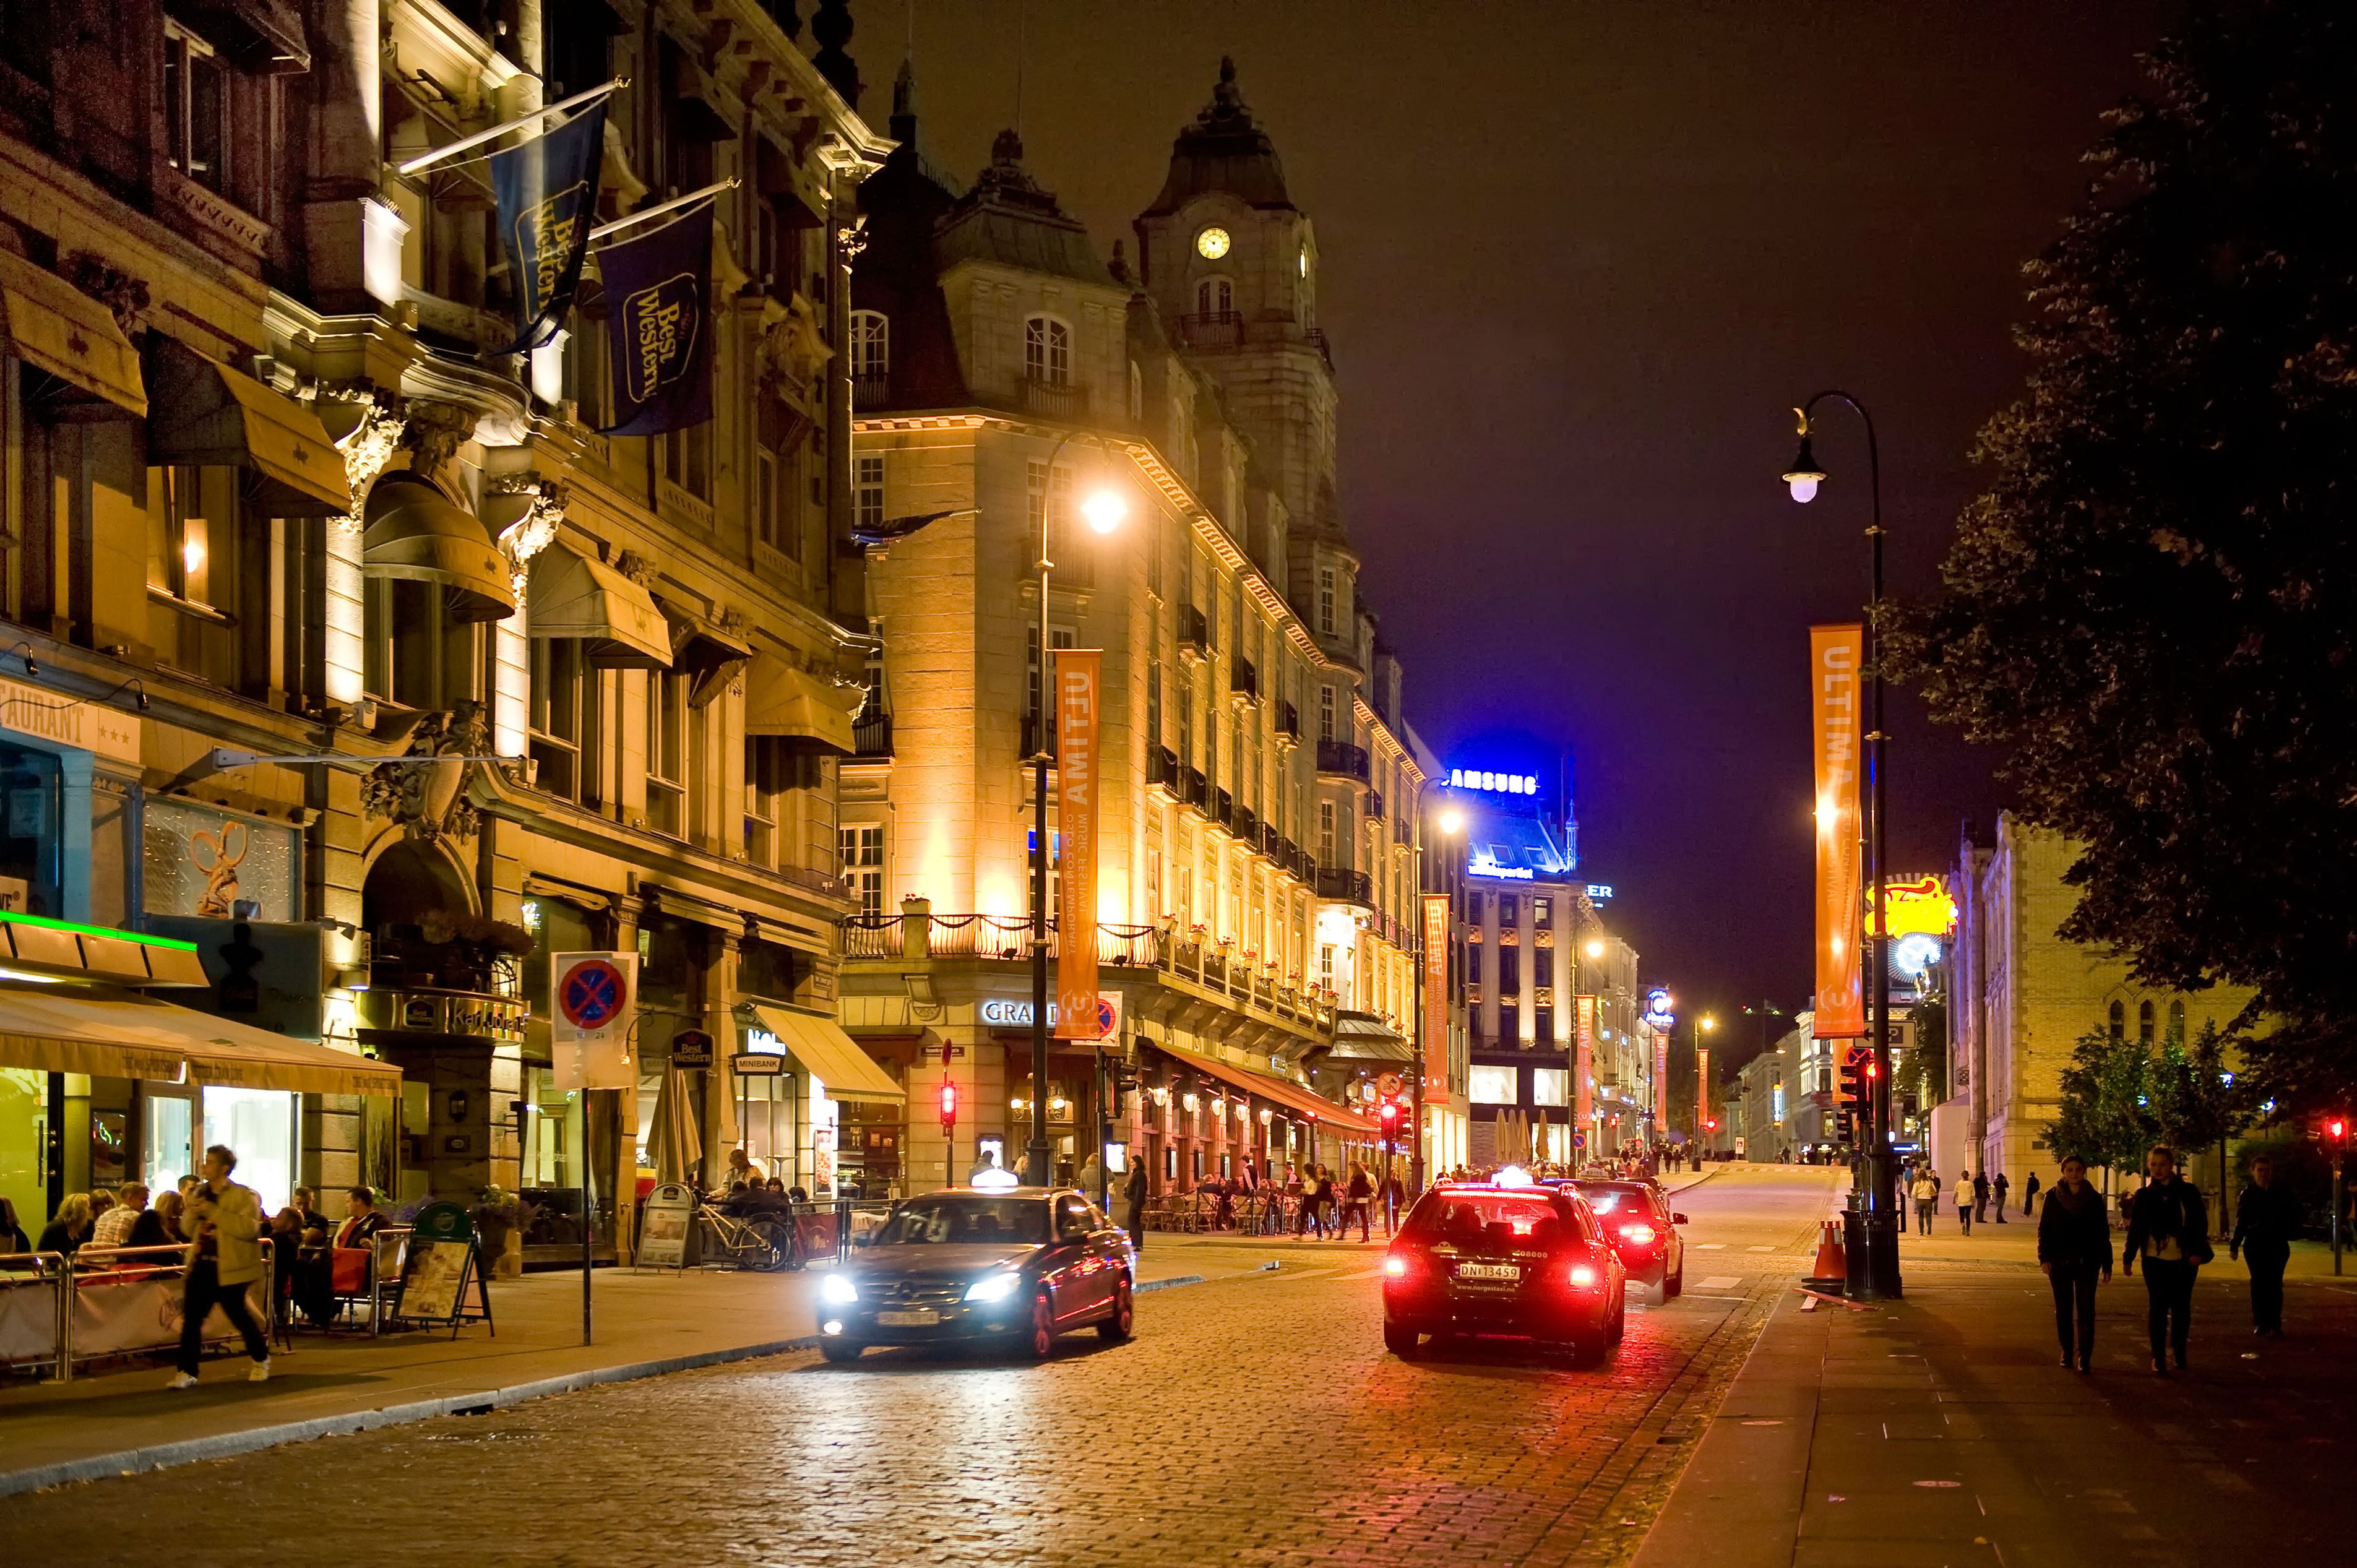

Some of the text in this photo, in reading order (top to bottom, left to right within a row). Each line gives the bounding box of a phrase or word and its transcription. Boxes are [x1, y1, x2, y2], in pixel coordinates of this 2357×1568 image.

[658, 301, 679, 364] Best
[637, 288, 659, 396] Western
[1824, 646, 1853, 784] ULTIMA
[1440, 769, 1536, 795] AMSUNG
[1585, 885, 1613, 898] ER
[681, 1043, 702, 1054] Best
[674, 1053, 712, 1062] Western
[738, 1060, 778, 1068] MINIBANK
[1462, 1265, 1517, 1278] DN 13459
[1456, 1285, 1515, 1293] www.norgestaxi.no
